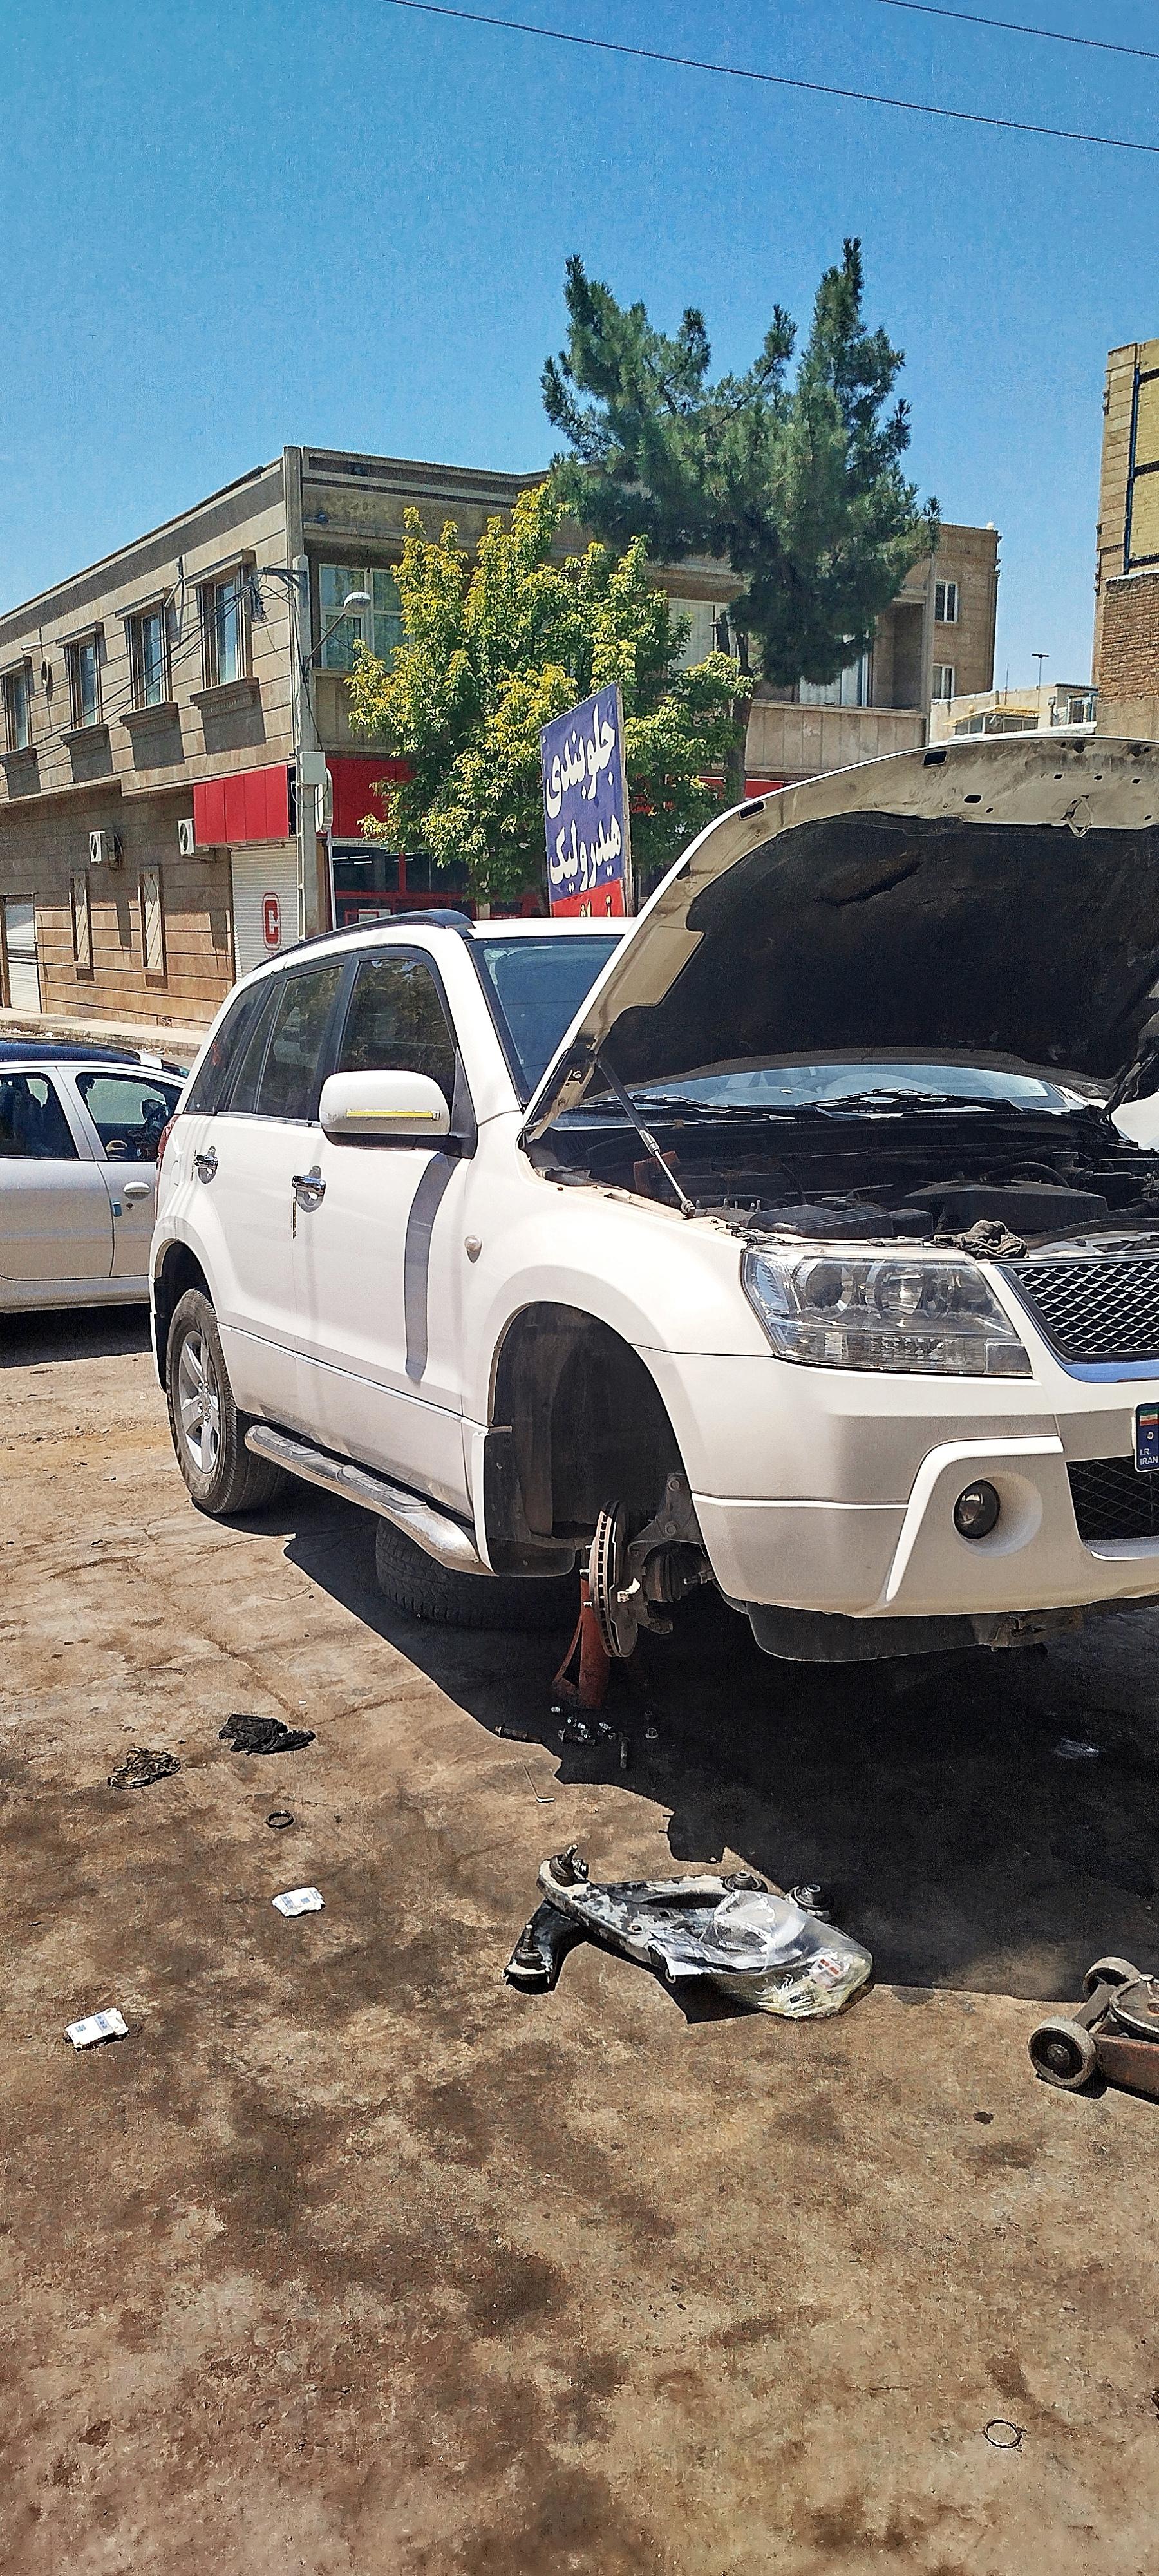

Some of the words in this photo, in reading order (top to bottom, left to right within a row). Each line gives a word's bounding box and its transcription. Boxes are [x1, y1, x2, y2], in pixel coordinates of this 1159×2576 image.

[547, 703, 616, 819] جلوبندی
[549, 814, 621, 893] هیدرولیک
[1140, 1456, 1158, 1465] IRAN
